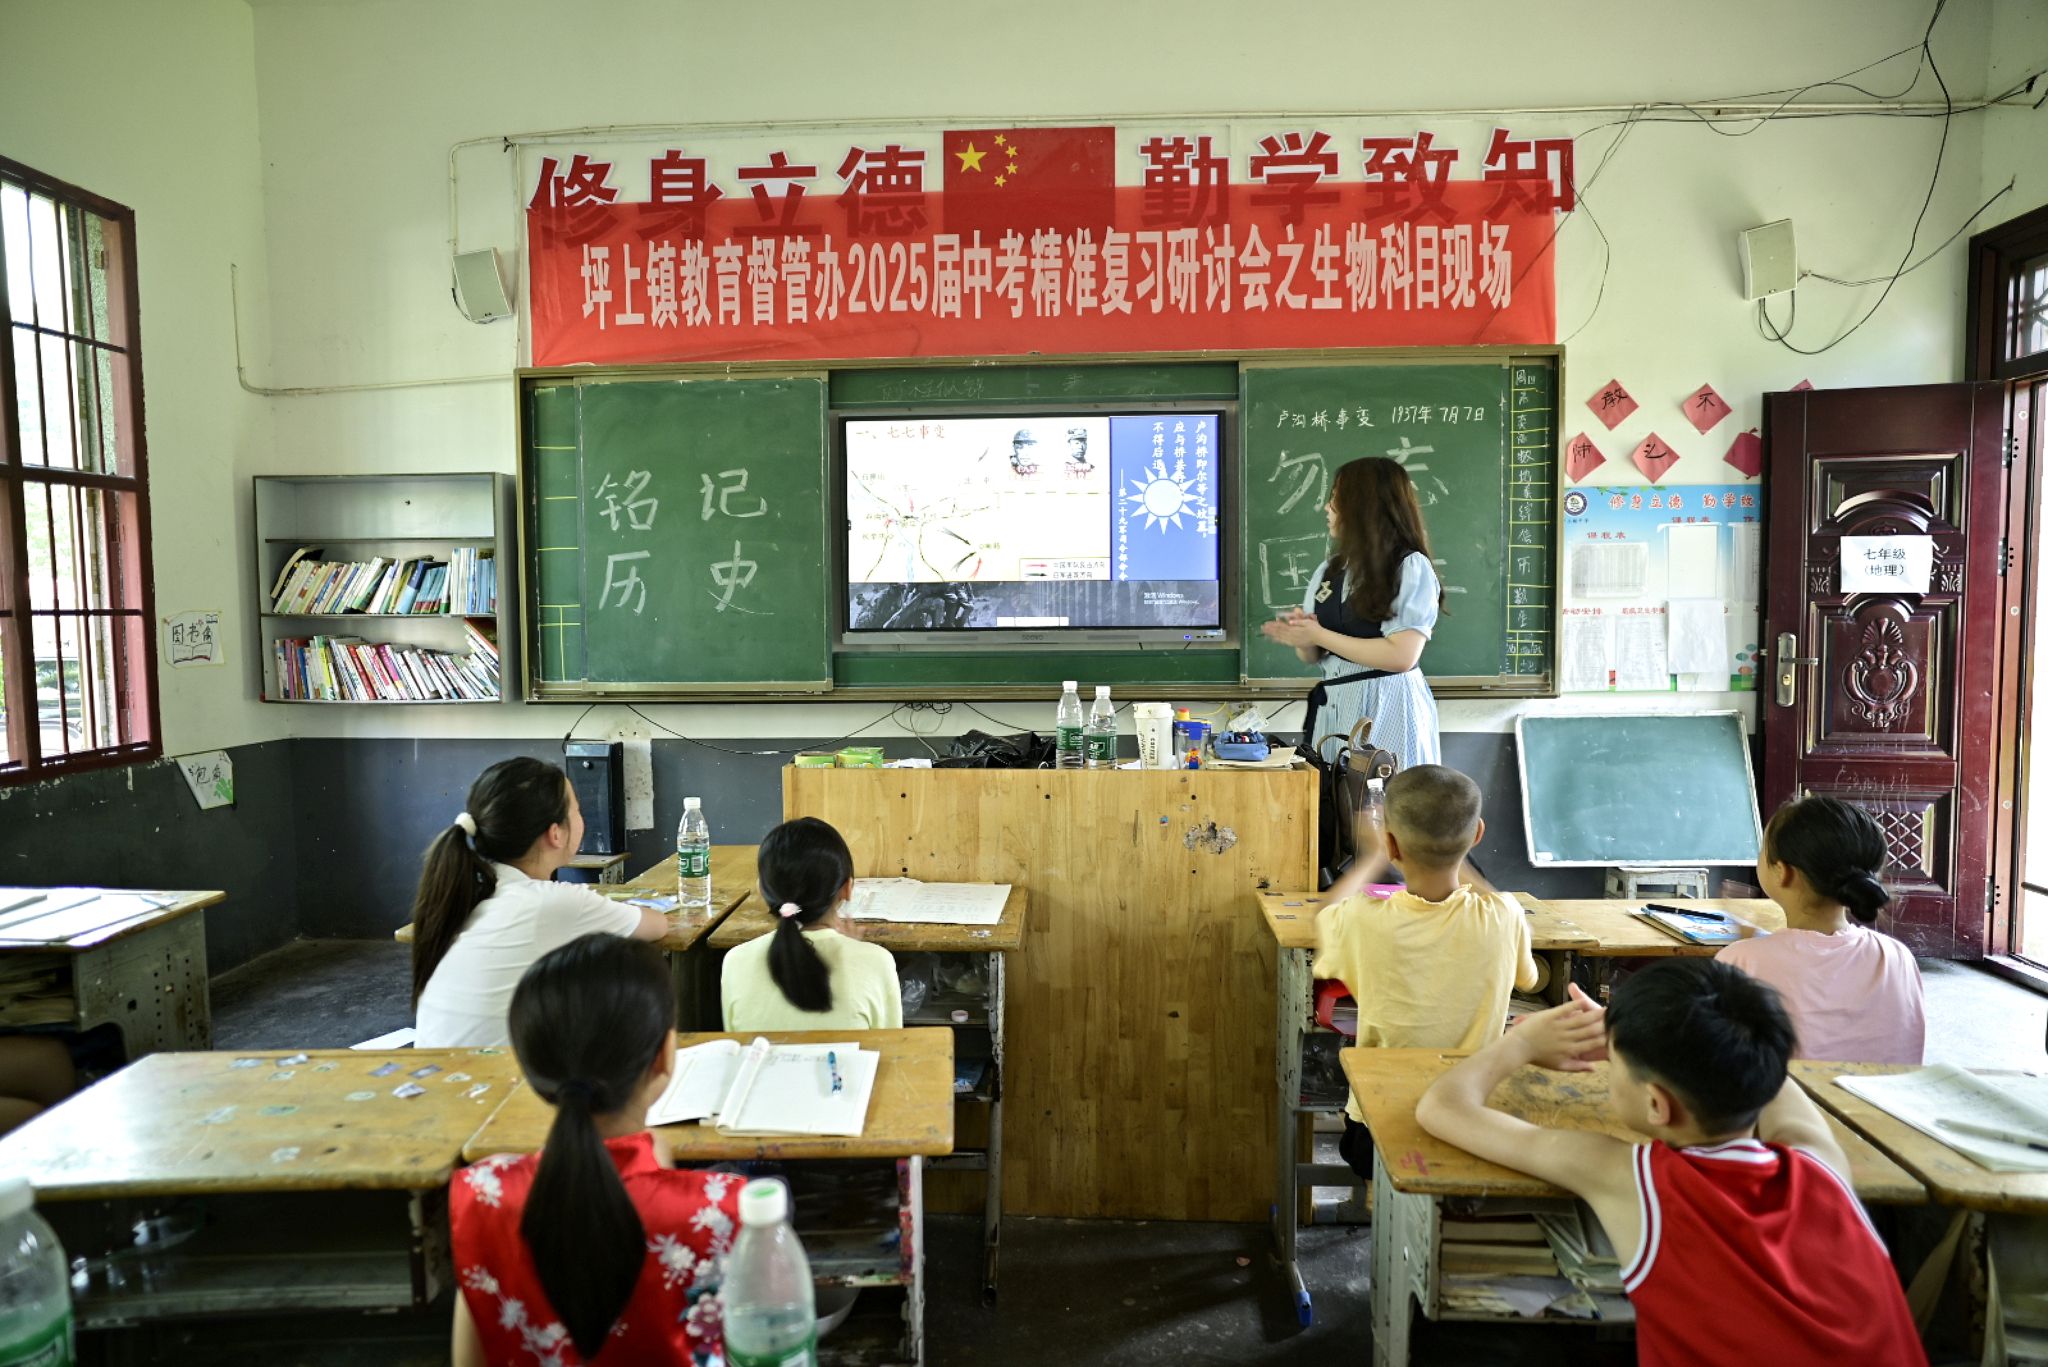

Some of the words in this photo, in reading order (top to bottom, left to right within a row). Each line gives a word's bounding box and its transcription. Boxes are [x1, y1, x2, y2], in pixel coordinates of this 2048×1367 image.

[528, 144, 928, 249] 修身立德
[1138, 127, 1576, 229] 勤学致知
[580, 219, 1513, 330] 坪上镇教育督管办2025届中考精准复习研讨会之生物科目现场
[1276, 405, 1376, 433] 卢沟桥事变
[1601, 387, 1628, 410] 教
[1696, 391, 1717, 413] 不
[594, 467, 769, 532] 铭记
[1608, 494, 1684, 511] 修身立德
[1863, 548, 1907, 560] 七年级
[598, 539, 775, 616] 历史
